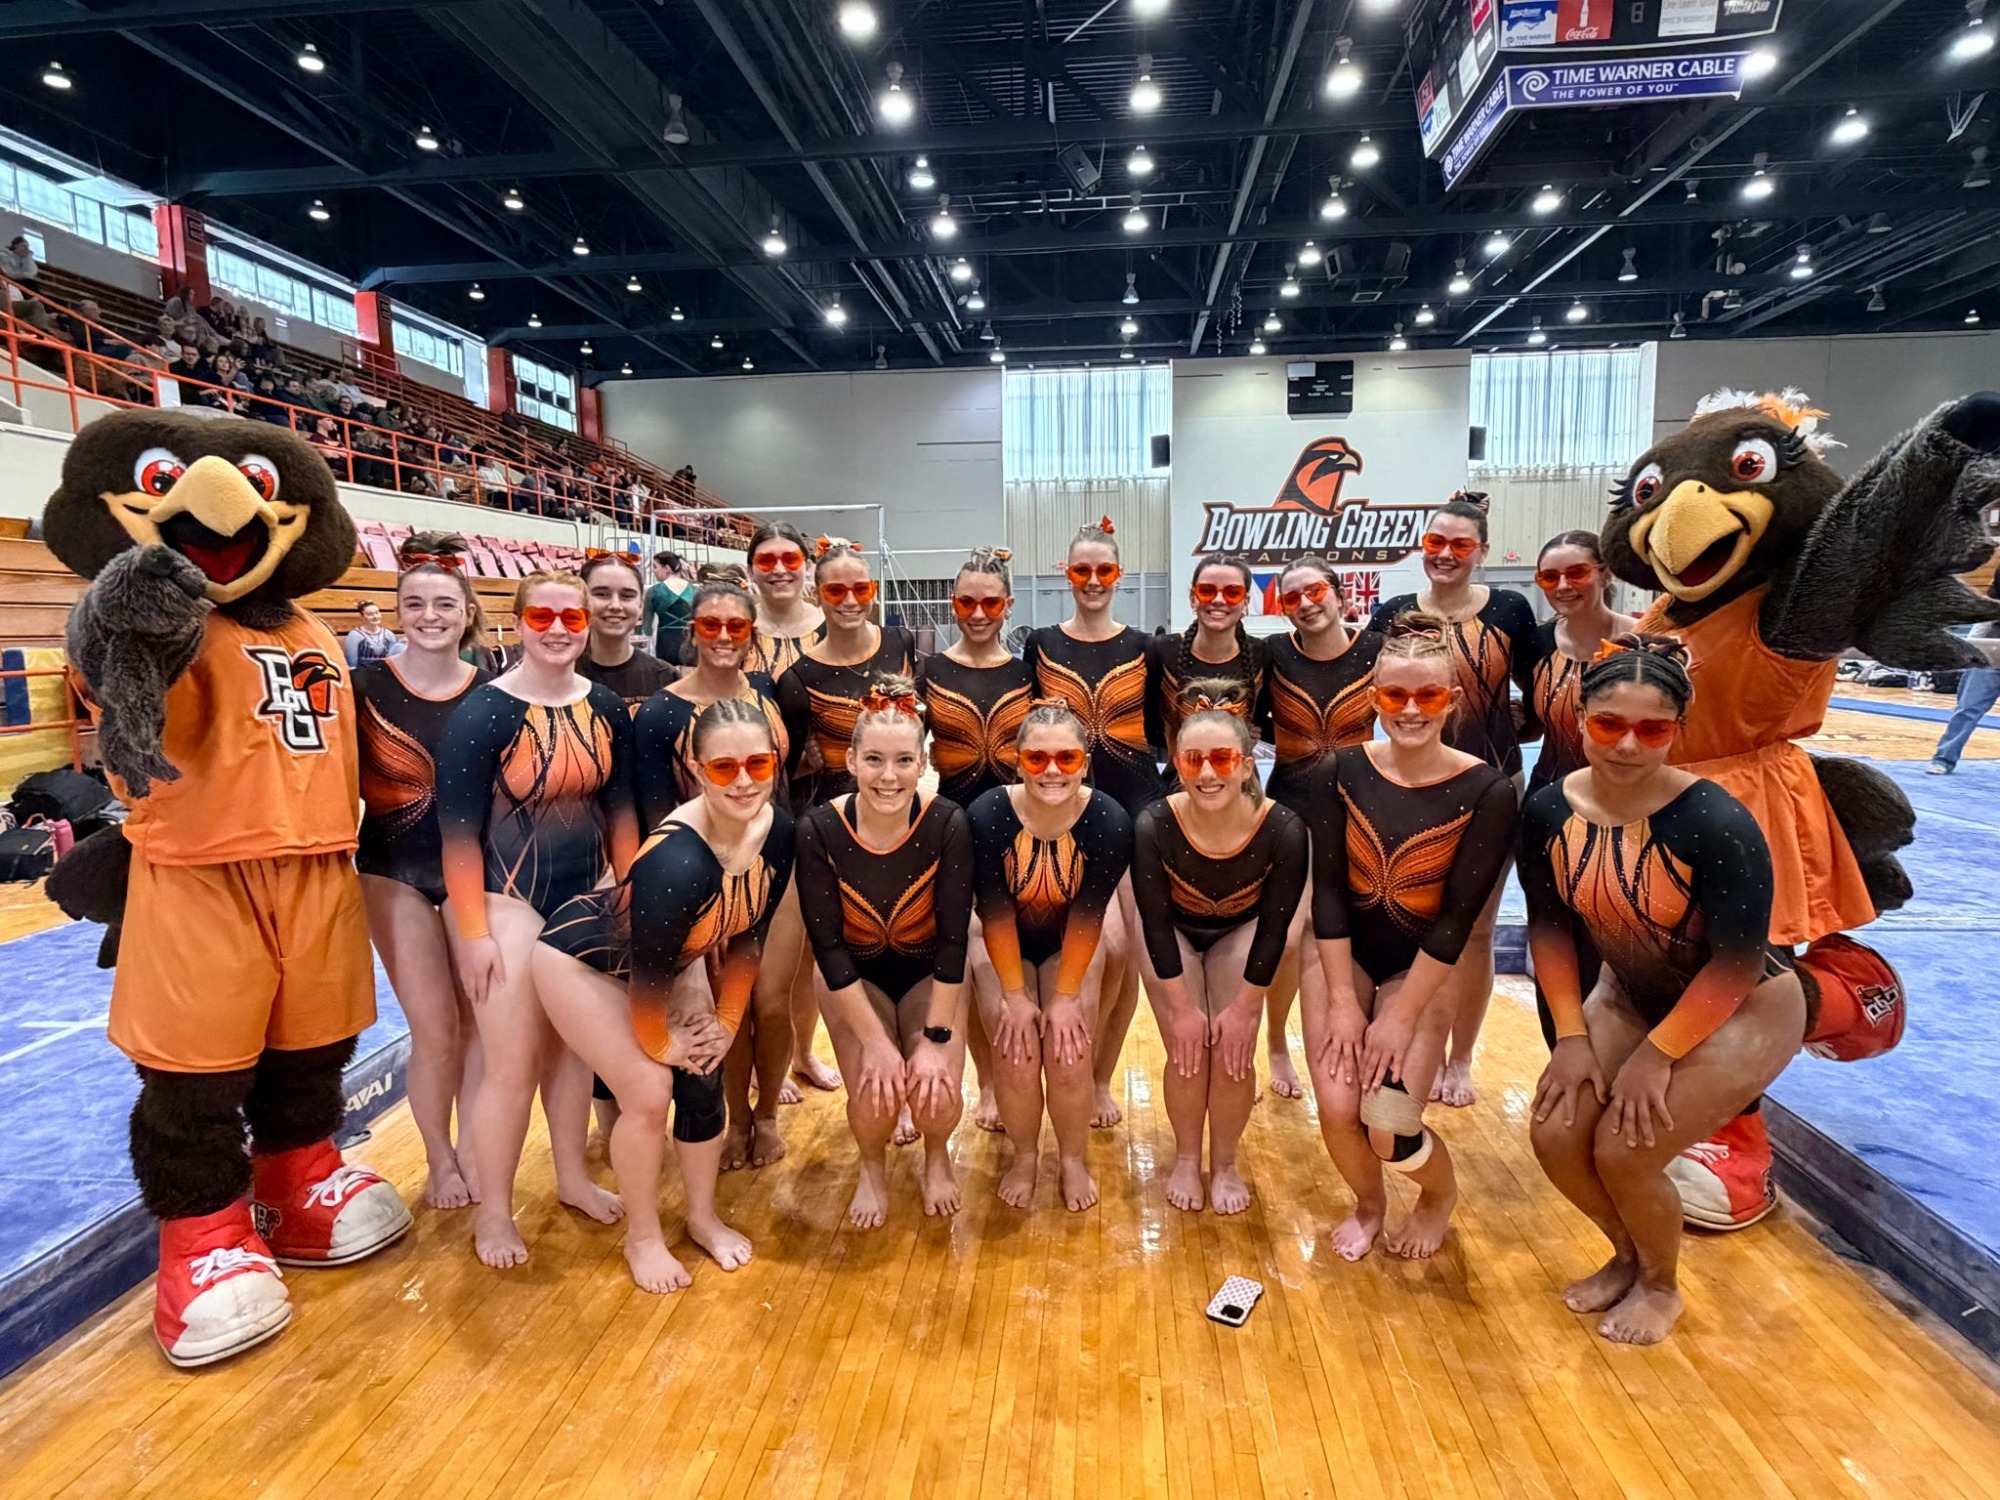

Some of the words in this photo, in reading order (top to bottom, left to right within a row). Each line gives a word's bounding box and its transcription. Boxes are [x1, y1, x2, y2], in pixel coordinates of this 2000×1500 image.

[1552, 67, 1595, 85] TIME
[1598, 63, 1674, 82] WARNER
[1677, 58, 1735, 77] CABLE
[1552, 89, 1574, 100] THE
[1579, 87, 1622, 98] POWER
[1626, 85, 1643, 95] OF
[1202, 507, 1332, 551] BOWLING
[1334, 504, 1438, 549] GREEN
